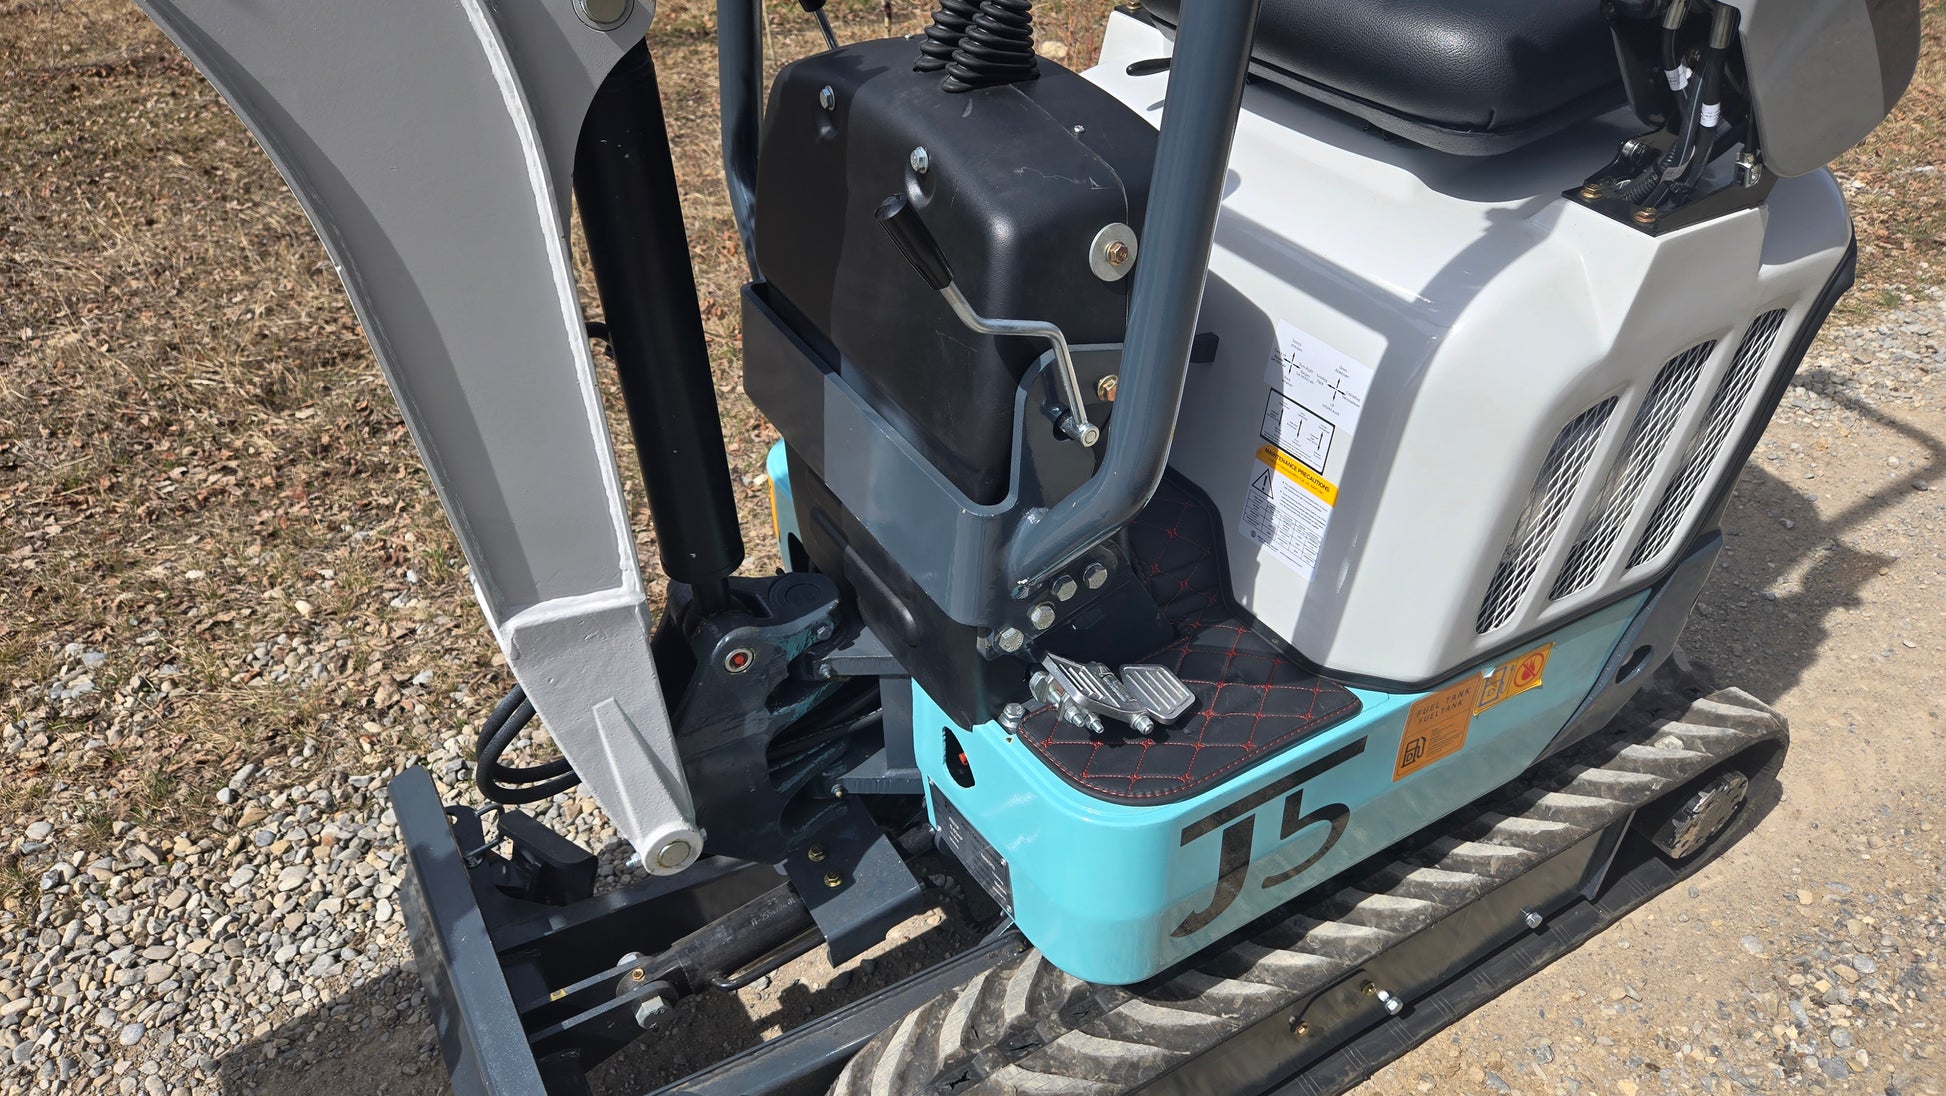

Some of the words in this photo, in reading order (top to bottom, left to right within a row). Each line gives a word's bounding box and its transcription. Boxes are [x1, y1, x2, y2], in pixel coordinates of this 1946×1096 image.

[1264, 447, 1297, 471] MAINTENANCE
[1297, 467, 1330, 493] PRECAUTIONS
[1417, 702, 1440, 718] FUEL
[1446, 687, 1471, 704] TANK
